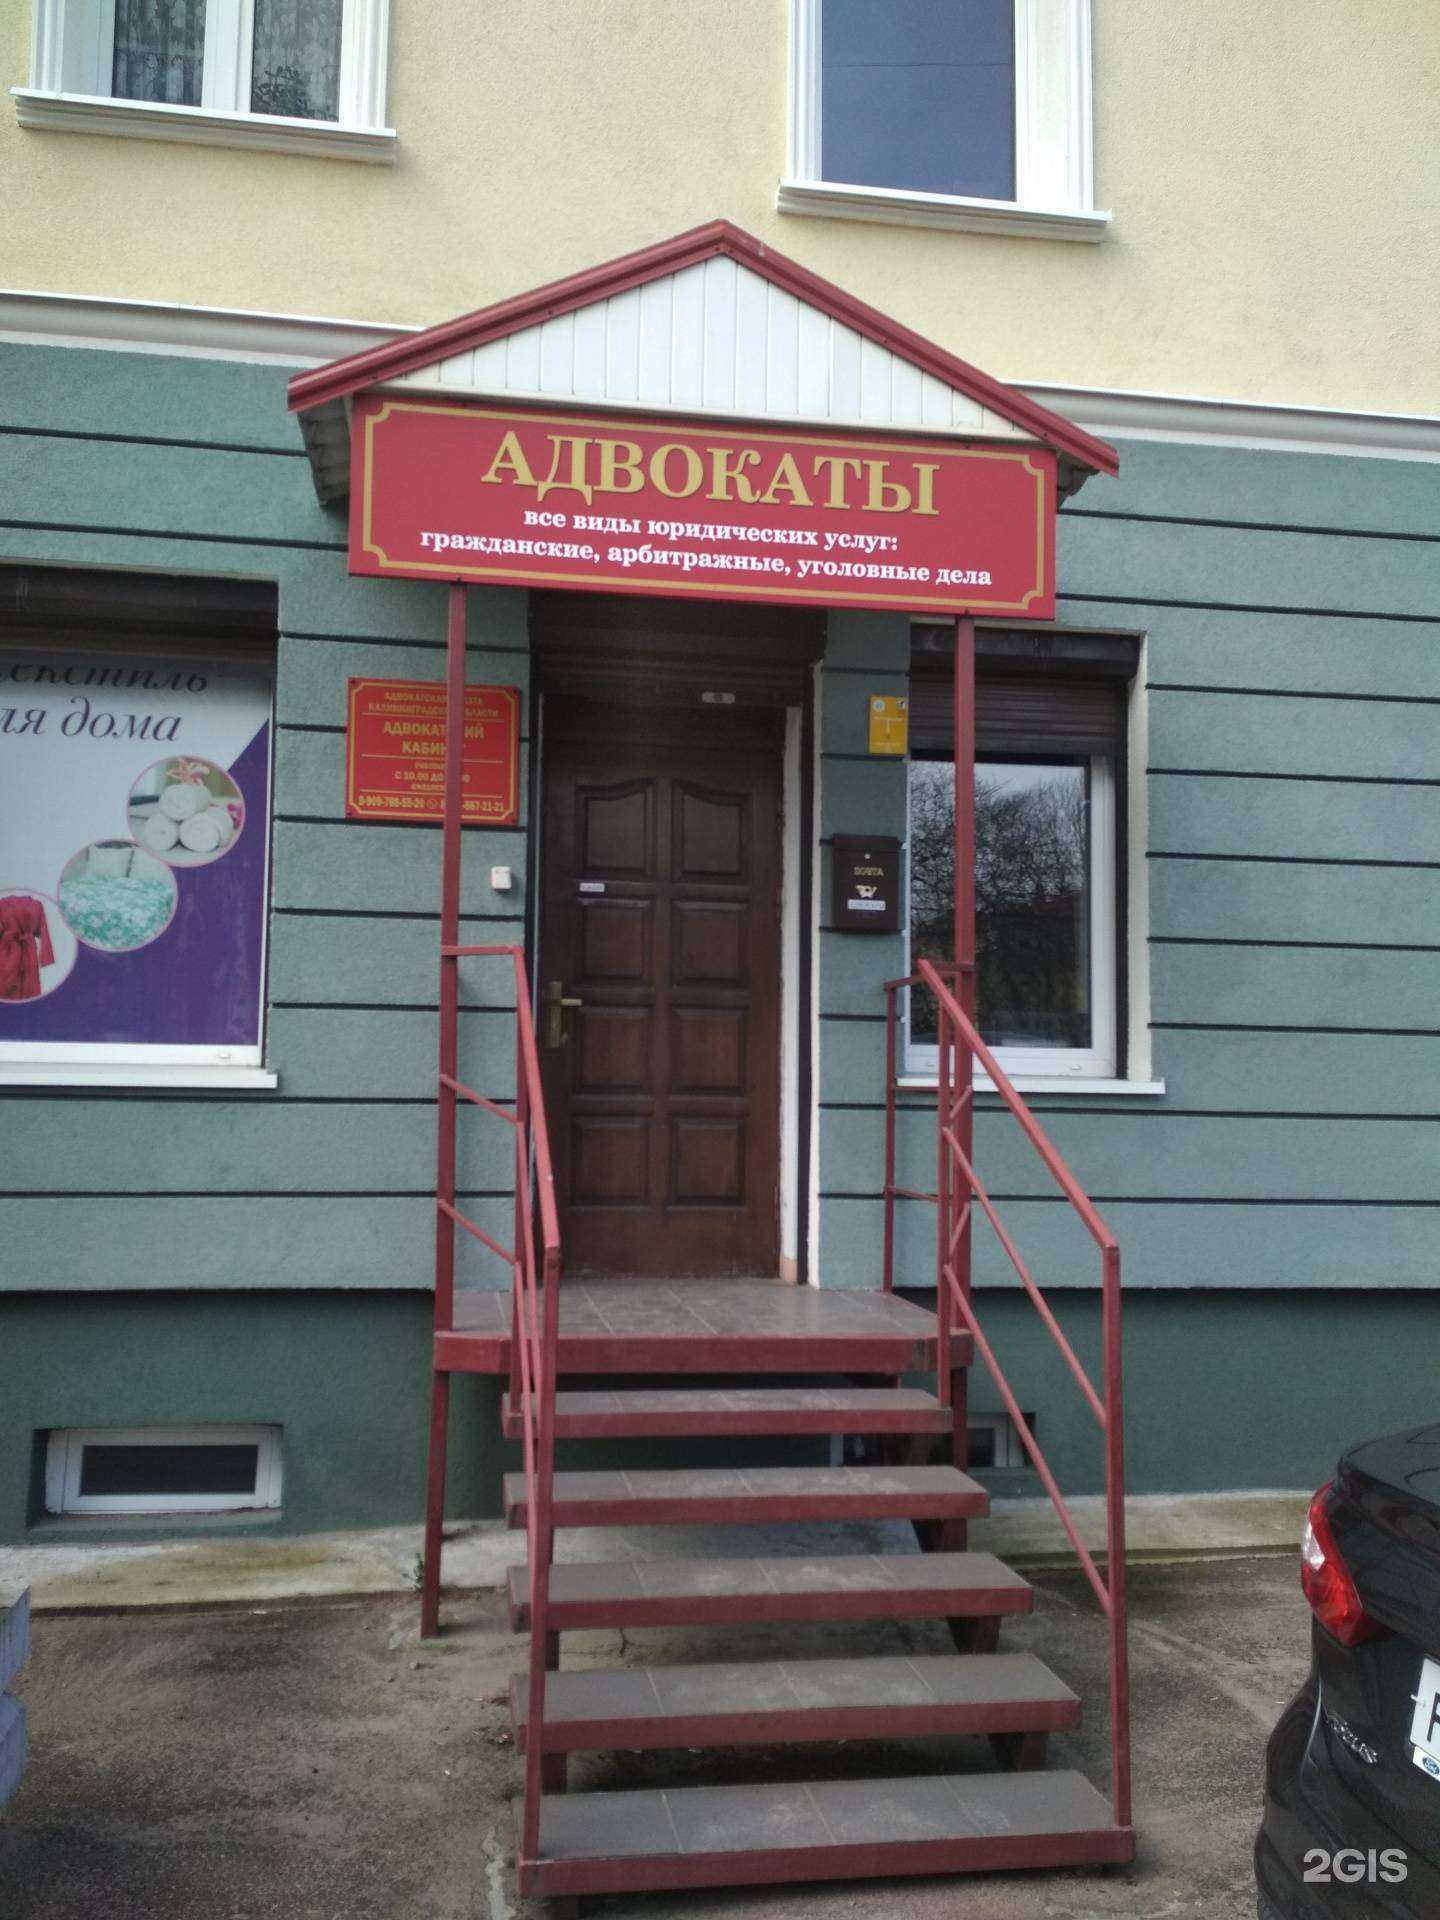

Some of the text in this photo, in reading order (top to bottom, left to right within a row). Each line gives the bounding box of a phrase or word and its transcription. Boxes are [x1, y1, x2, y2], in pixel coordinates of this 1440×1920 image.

[481, 432, 940, 516] АДВОКАТЫ
[523, 510, 898, 553] все виды юридических услуг:
[420, 531, 992, 586] гражданские, арбитражные, уголовные дела
[0, 663, 208, 692] екстиль
[0, 696, 182, 742] ля дома
[383, 721, 485, 739] АДВОКАТИЙ
